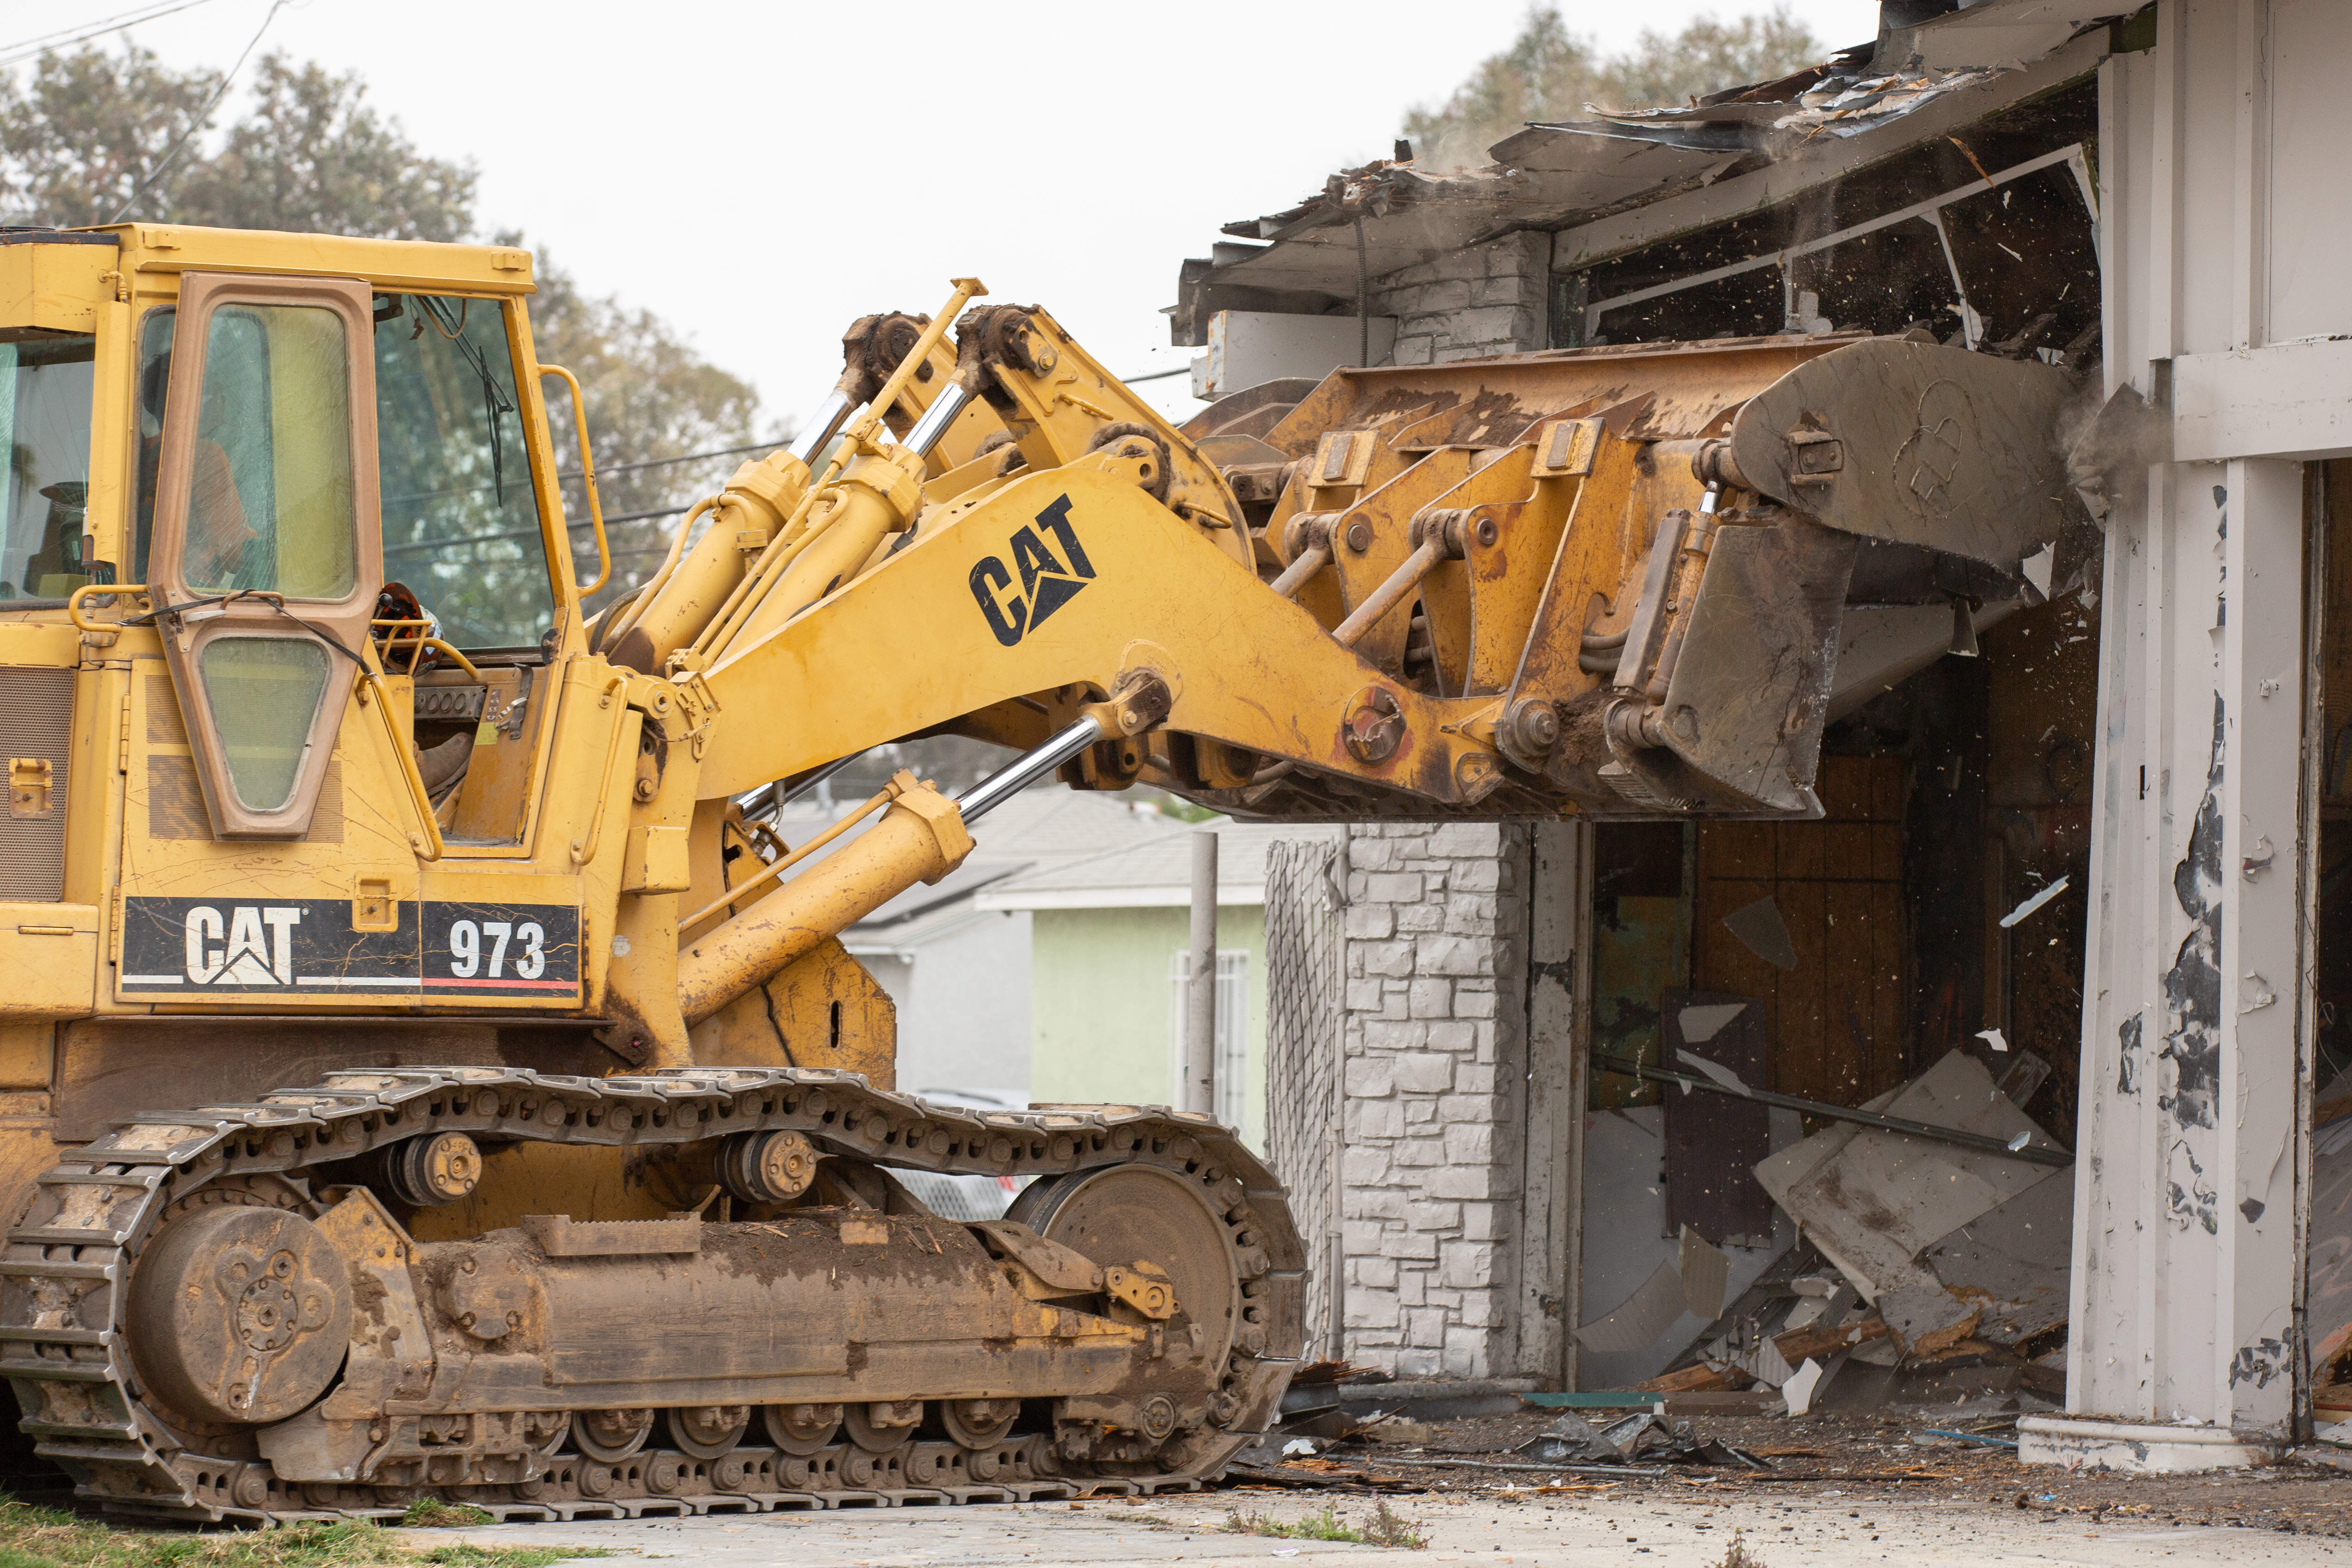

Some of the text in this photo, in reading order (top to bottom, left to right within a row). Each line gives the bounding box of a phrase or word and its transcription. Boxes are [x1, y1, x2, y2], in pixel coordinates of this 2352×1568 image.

[969, 493, 1097, 647] CAT
[186, 906, 300, 985] CAT
[450, 920, 545, 979] 973
